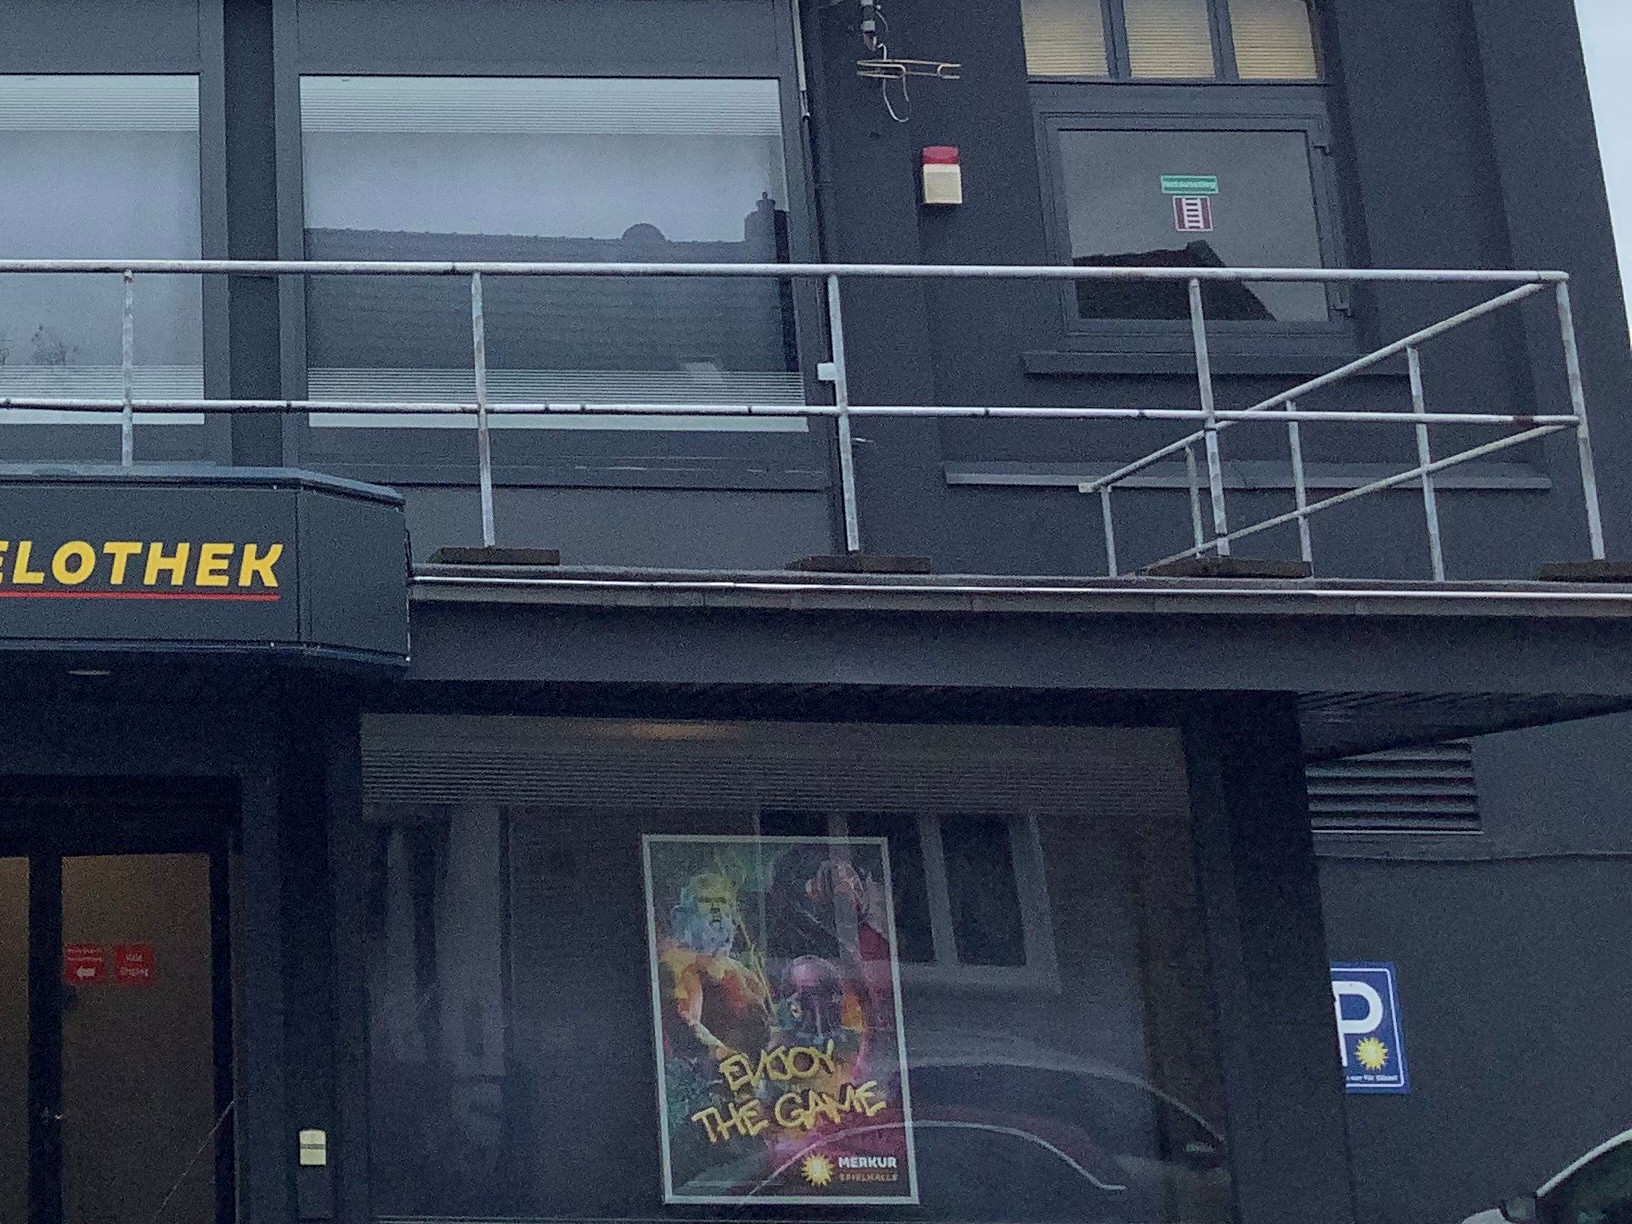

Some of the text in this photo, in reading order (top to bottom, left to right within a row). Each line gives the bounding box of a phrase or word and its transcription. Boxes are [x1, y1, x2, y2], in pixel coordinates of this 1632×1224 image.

[1333, 981, 1383, 1066] P
[720, 1038, 835, 1091] ENJOY
[691, 1080, 887, 1144] THE GAME
[838, 1156, 898, 1169] MERKUR
